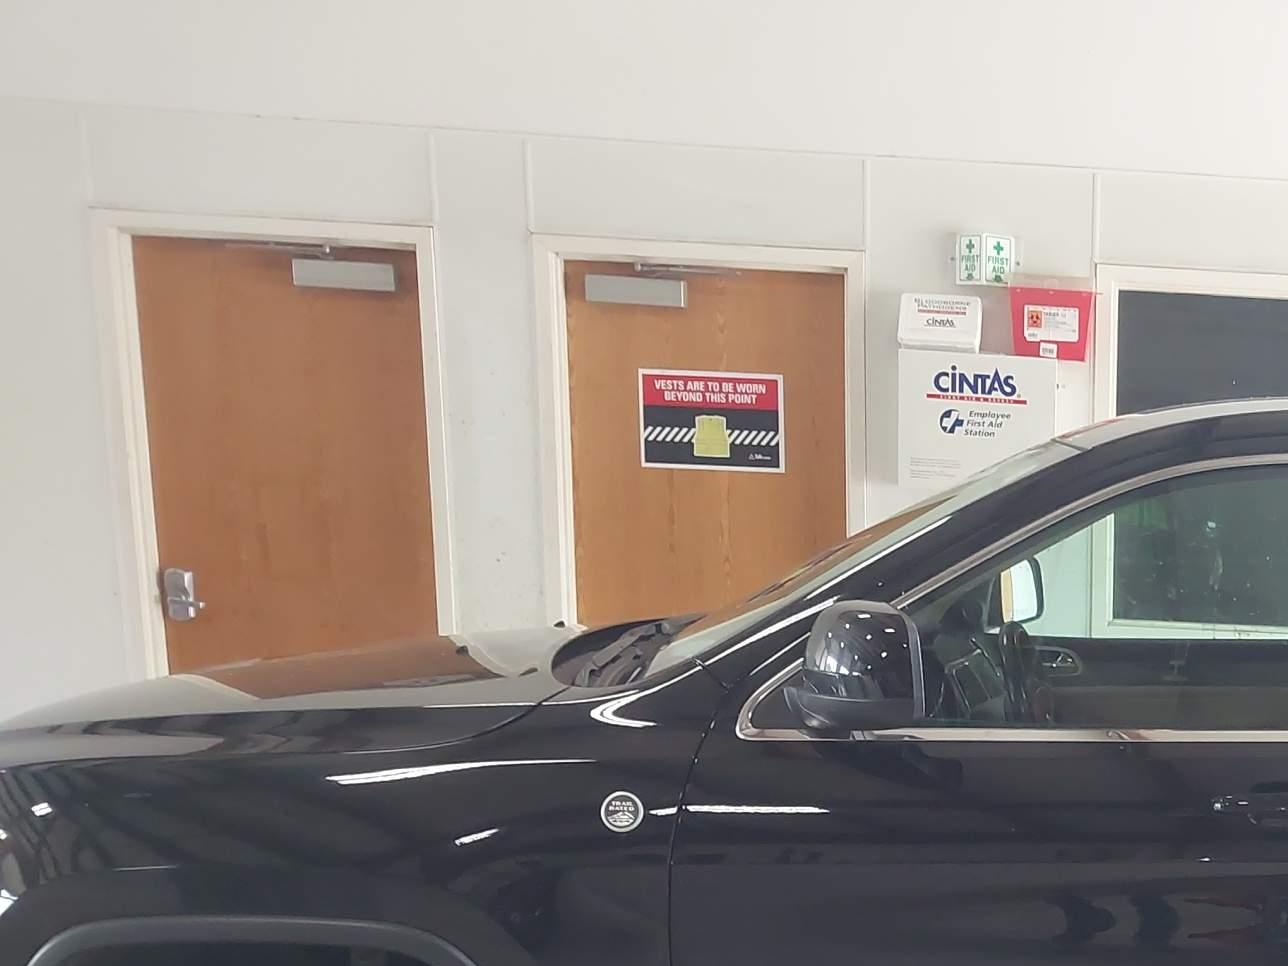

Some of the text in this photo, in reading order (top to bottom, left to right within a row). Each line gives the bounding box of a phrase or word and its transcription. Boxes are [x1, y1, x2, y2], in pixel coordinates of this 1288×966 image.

[961, 254, 980, 263] FIRST
[987, 256, 1009, 266] FIRST
[964, 263, 976, 272] AID
[991, 266, 1005, 274] AID
[654, 379, 766, 394] VESTS ARE TO BE WORN
[664, 391, 757, 405] BEYOND THIS POINT
[969, 410, 1011, 421] Employee
[966, 419, 1003, 429] First Aid
[964, 428, 996, 438] Station
